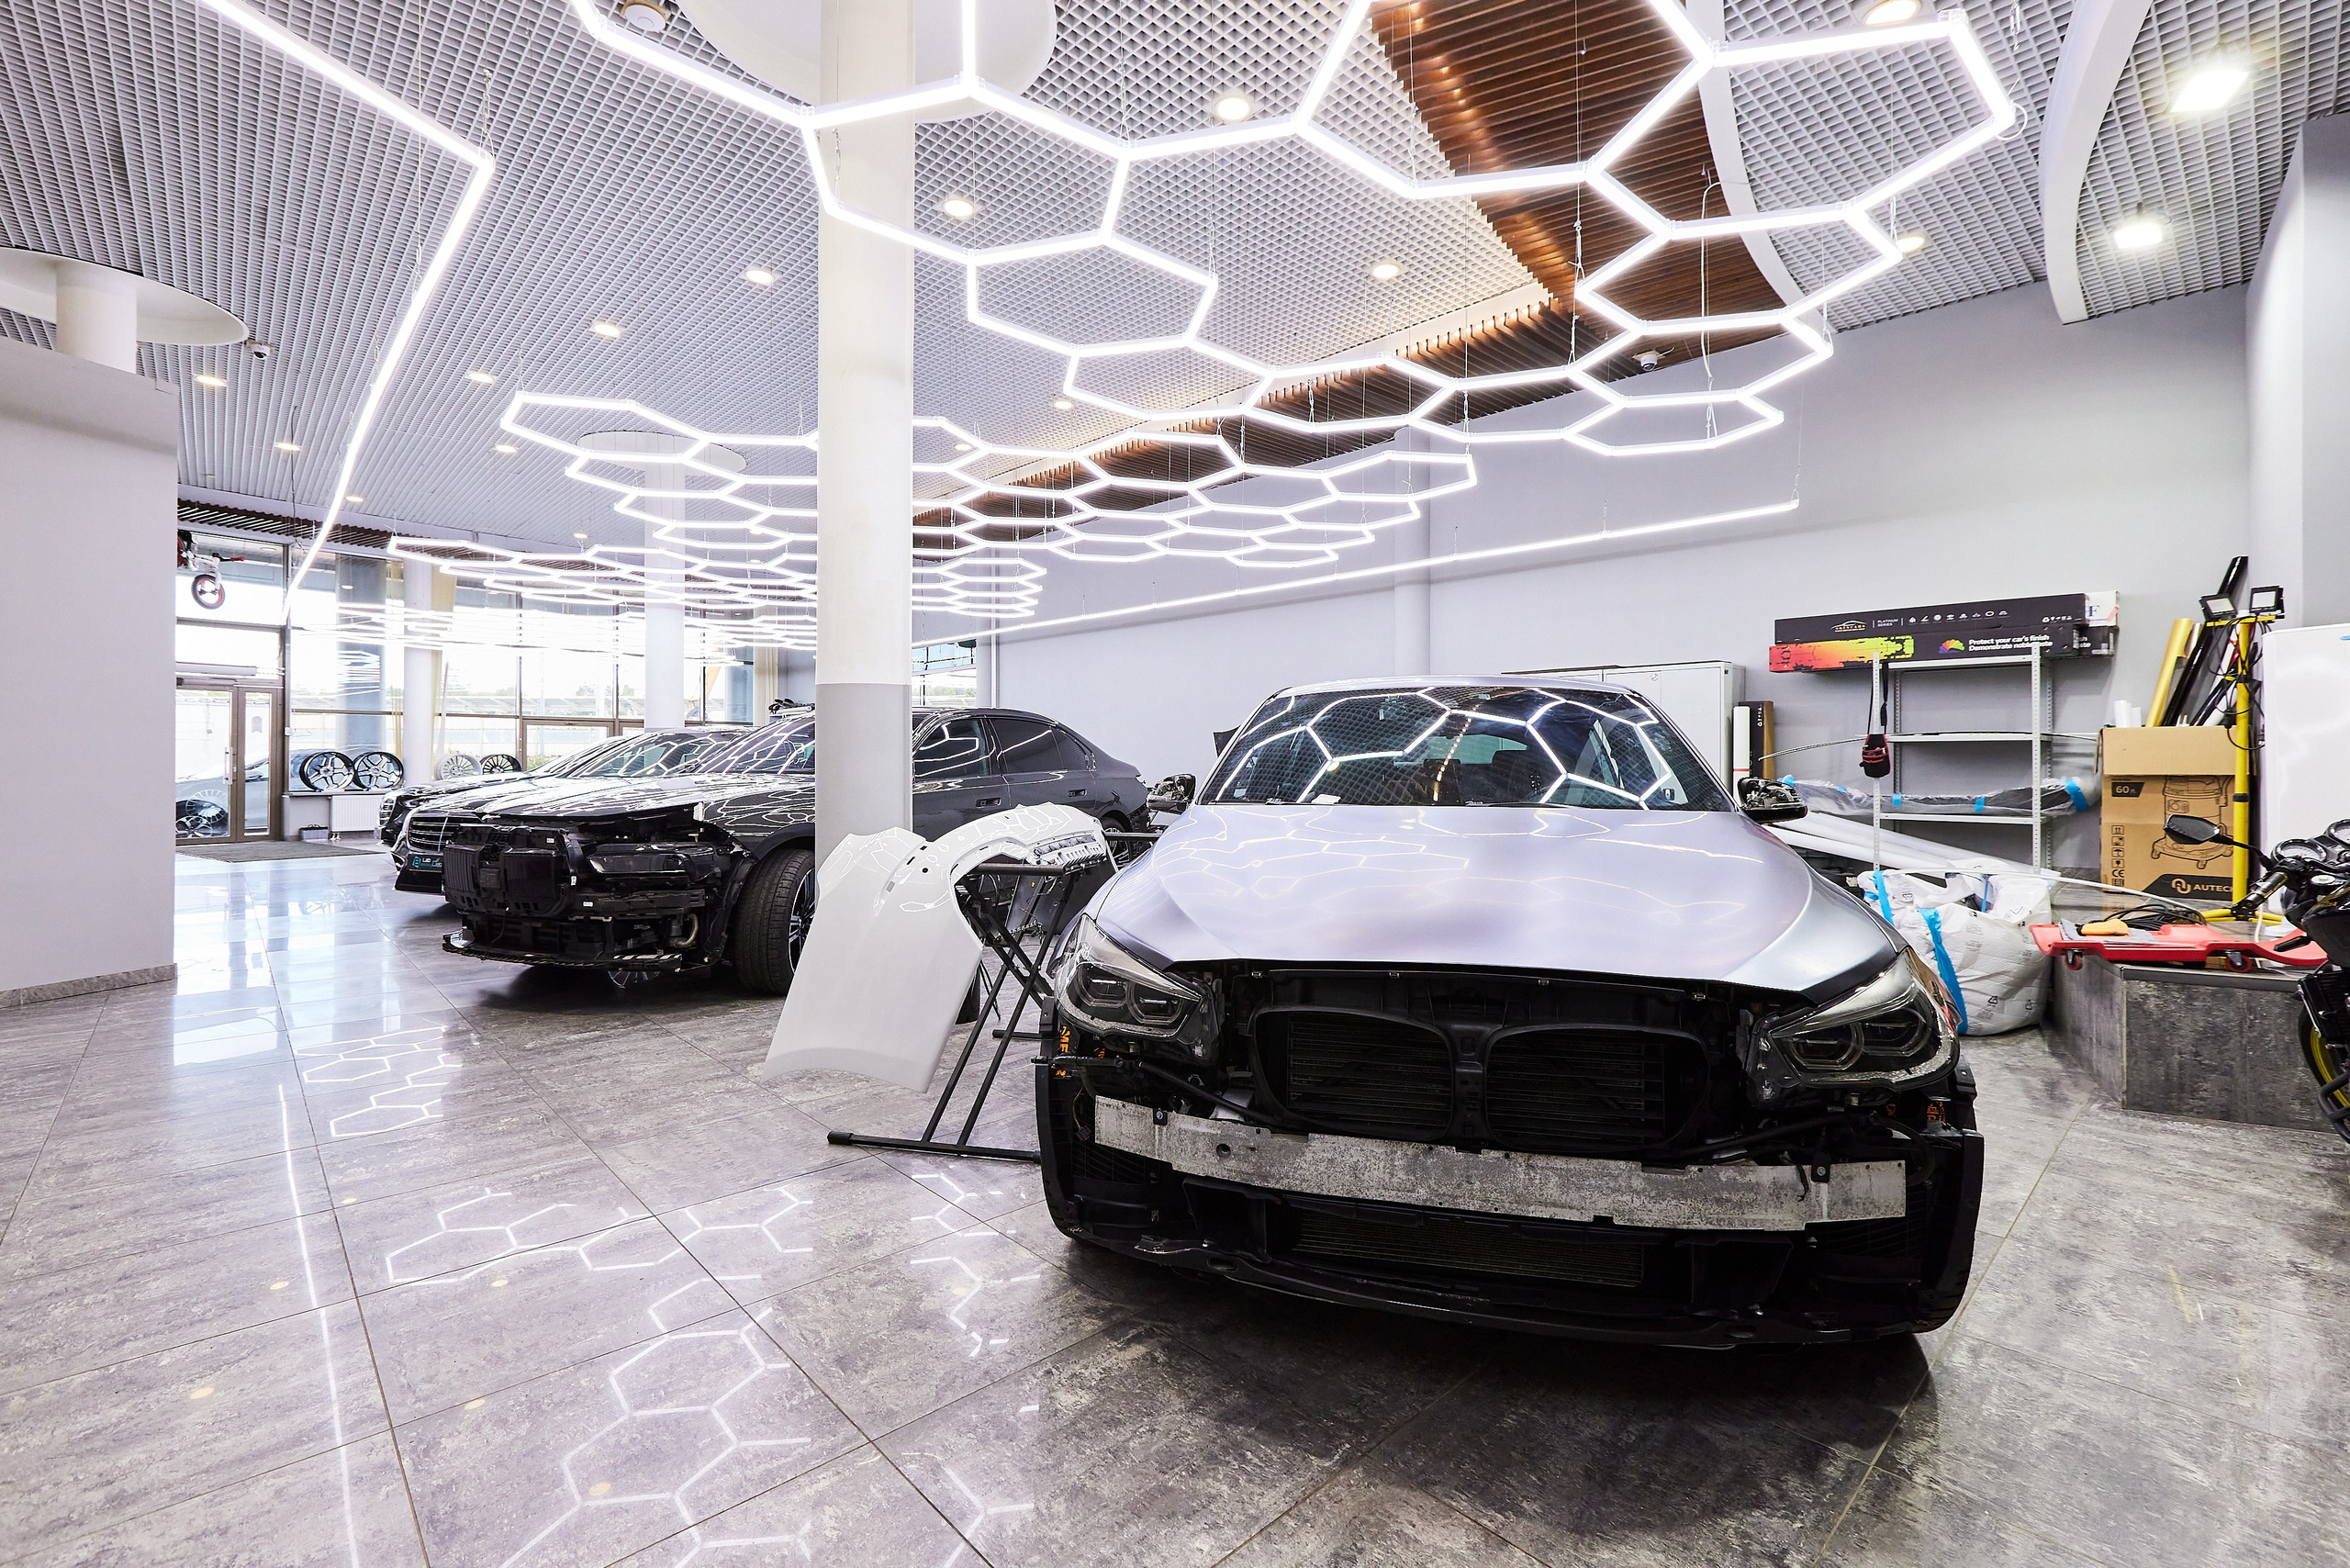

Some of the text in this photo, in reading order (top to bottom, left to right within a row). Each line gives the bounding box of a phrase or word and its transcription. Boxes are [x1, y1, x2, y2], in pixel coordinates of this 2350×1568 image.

[1995, 637, 2011, 645] your
[1968, 644, 2012, 652] Demonstrate
[2115, 785, 2130, 794] 60
